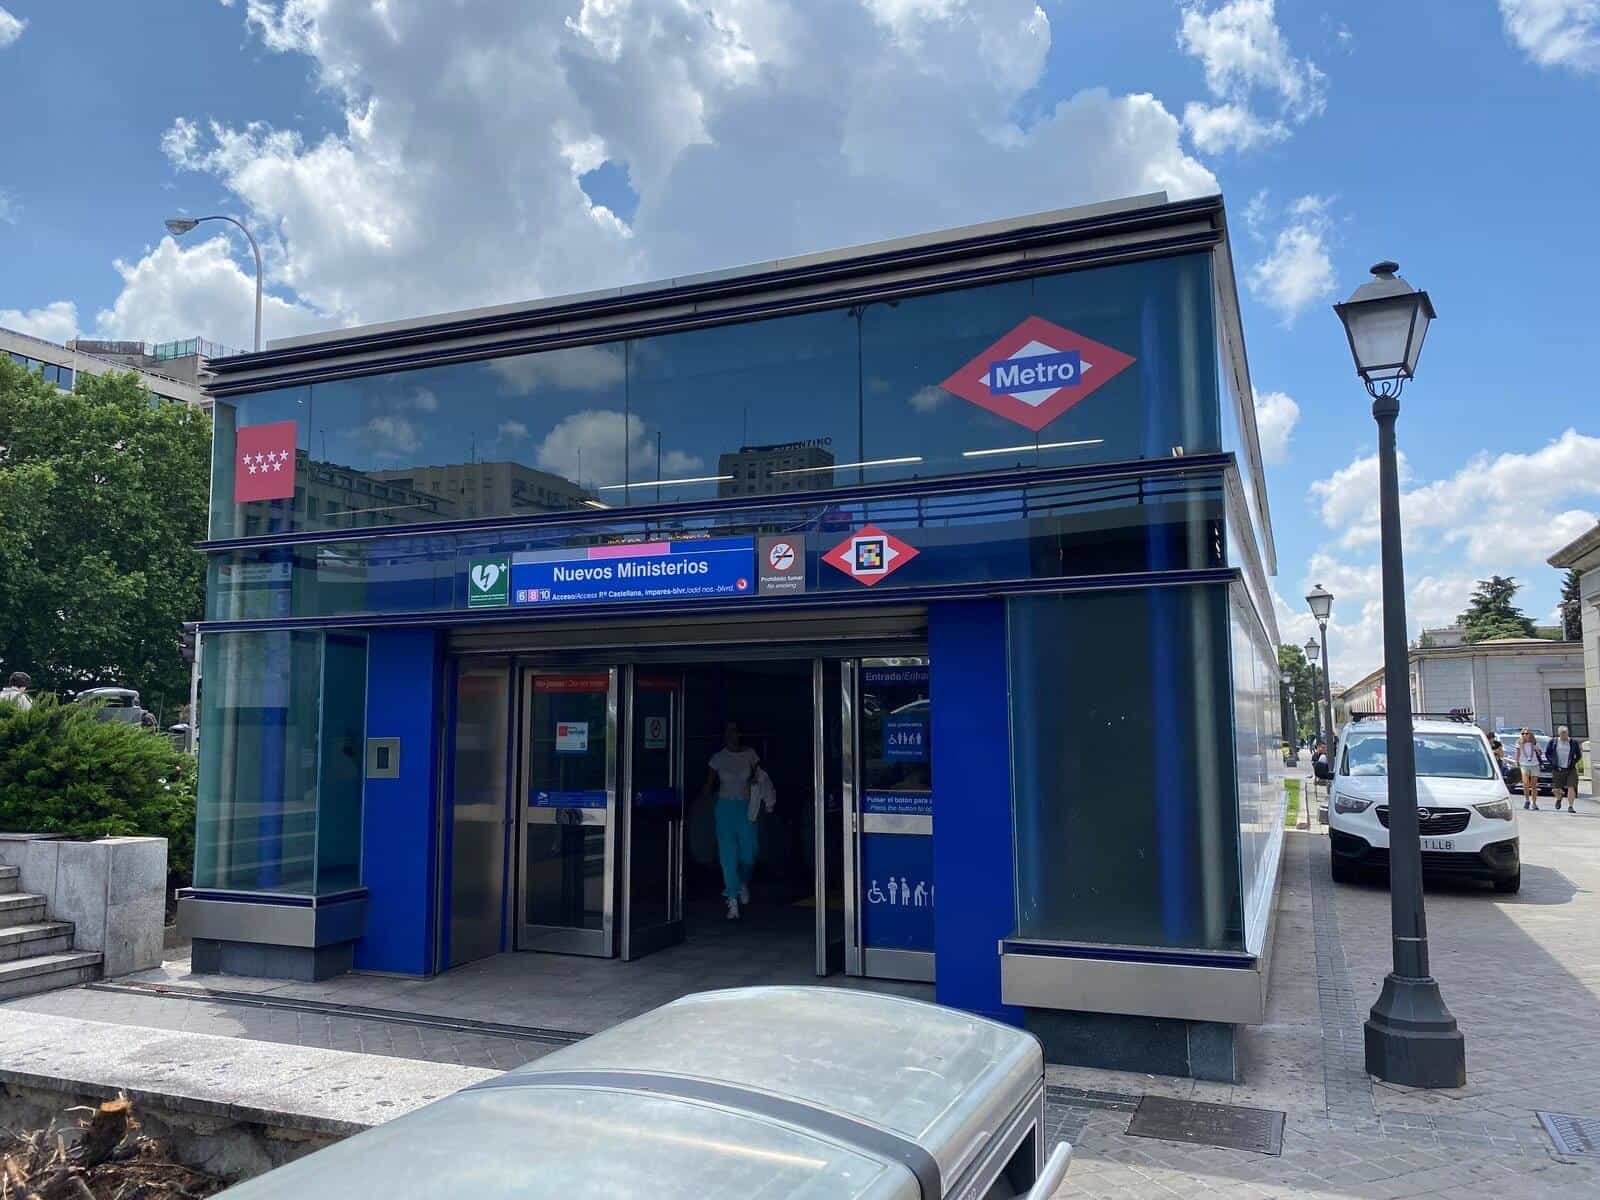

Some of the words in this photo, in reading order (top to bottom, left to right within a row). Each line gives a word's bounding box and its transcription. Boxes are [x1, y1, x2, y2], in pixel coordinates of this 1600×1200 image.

[996, 362, 1074, 389] Metro
[553, 565, 613, 582] Nuevos
[617, 559, 709, 578] Ministerios
[518, 591, 526, 601] 6
[540, 590, 550, 600] 10
[1432, 839, 1452, 850] LLB
